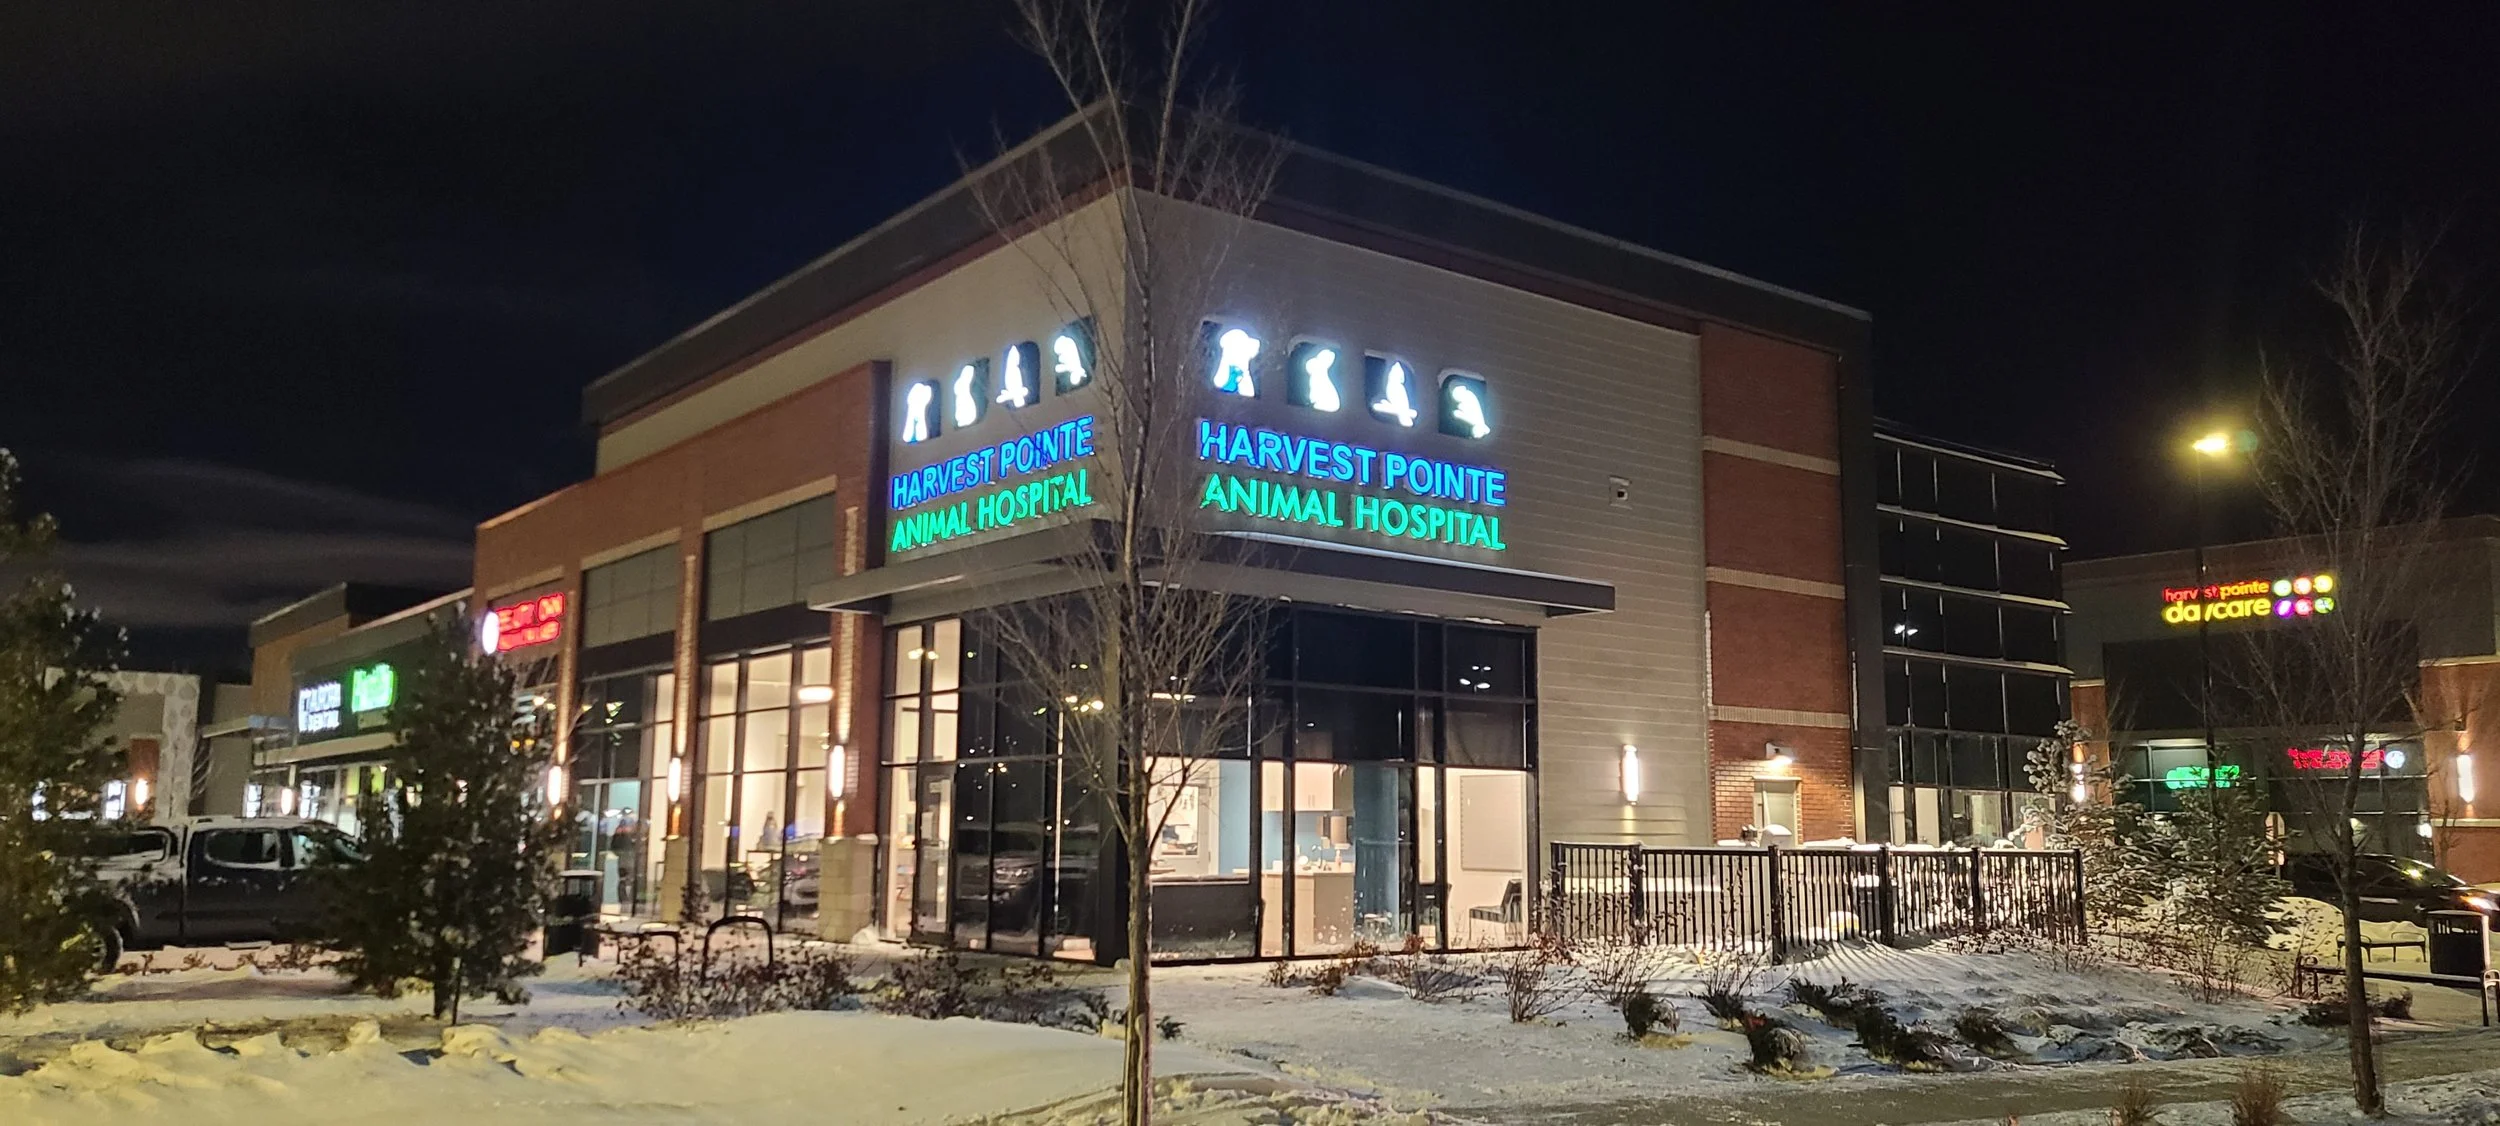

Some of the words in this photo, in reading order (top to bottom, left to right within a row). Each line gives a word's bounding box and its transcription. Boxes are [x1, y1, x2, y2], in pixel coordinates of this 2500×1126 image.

[892, 448, 996, 510] HARVEST
[999, 415, 1095, 478] POINTE
[1200, 420, 1376, 486] HARVEST
[1381, 453, 1506, 507] POINTE
[892, 502, 972, 552] ANIMAL
[978, 468, 1093, 531] HOSPITAL
[1200, 474, 1344, 528] ANIMAL
[1354, 496, 1507, 551] HOSPITAL
[2164, 586, 2220, 602] harvst
[2219, 580, 2271, 600] pointe
